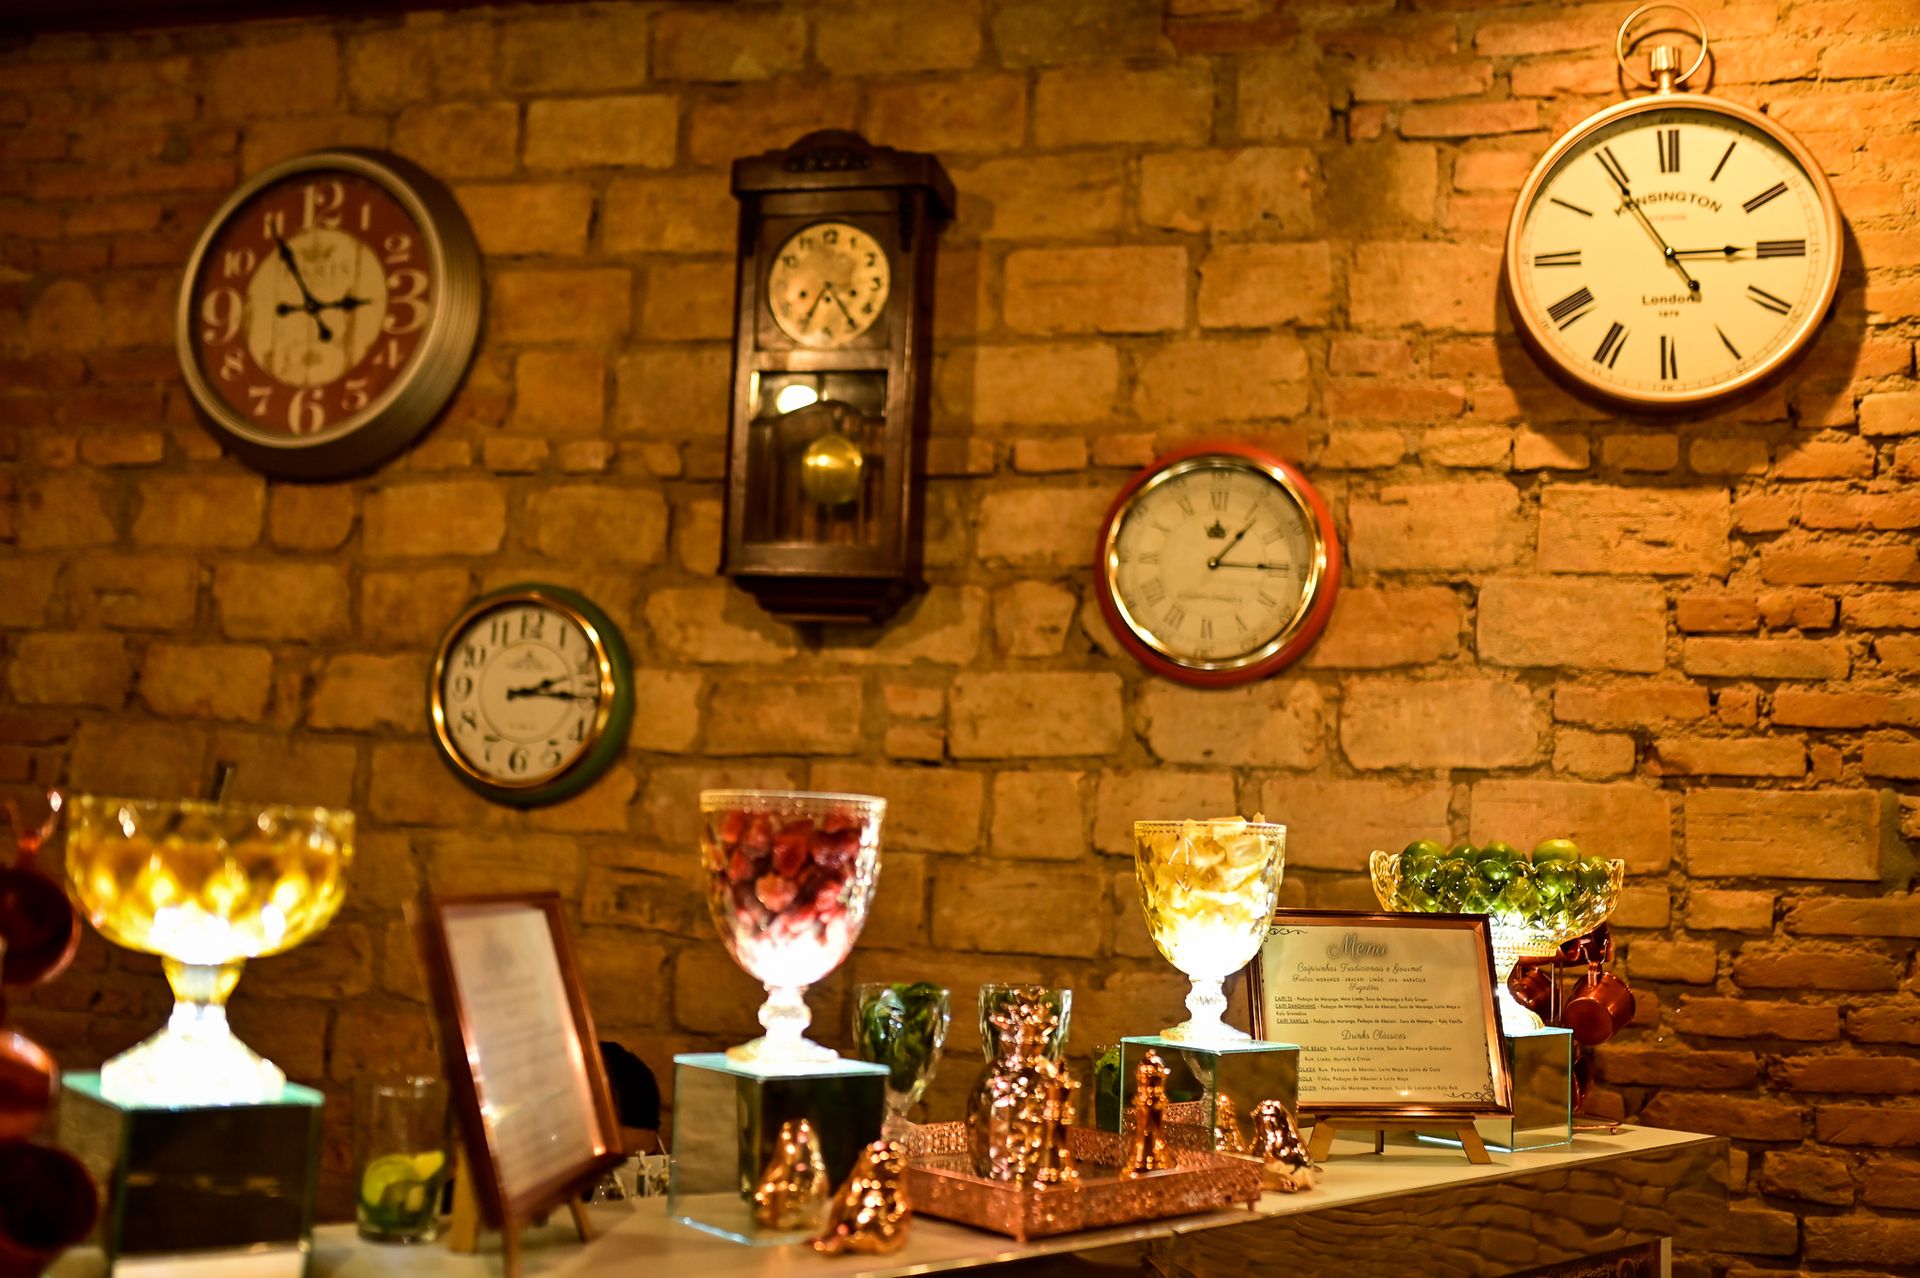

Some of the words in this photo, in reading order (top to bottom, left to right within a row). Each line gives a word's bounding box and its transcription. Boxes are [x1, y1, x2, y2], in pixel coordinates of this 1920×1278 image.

[1710, 141, 1736, 182] I
[302, 181, 344, 229] 12
[1742, 181, 1788, 214] II
[264, 210, 284, 239] 11
[360, 203, 371, 231] 1
[384, 233, 412, 264] 2
[823, 229, 838, 244] 12
[1756, 239, 1805, 258] III
[223, 250, 256, 278] 10
[866, 252, 875, 266] 2
[871, 276, 880, 292] 3
[383, 269, 430, 334] 3
[1642, 294, 1698, 305] London
[201, 287, 244, 345] 9
[220, 349, 244, 381] 8
[372, 338, 403, 369] 4
[248, 386, 272, 416] 7
[341, 378, 370, 411] 5
[288, 388, 325, 435] 6
[491, 618, 509, 647] 11
[520, 611, 545, 640] 12
[560, 620, 566, 649] 1
[464, 644, 485, 670] 10
[574, 646, 594, 675] 2
[452, 676, 472, 704] 9
[457, 710, 478, 734] 8
[568, 717, 585, 742] 4
[484, 734, 502, 762] 7
[508, 744, 529, 773] 6
[540, 738, 562, 768] 5
[1327, 932, 1388, 961] Menu
[1297, 962, 1337, 974] Caipirinhas
[1340, 963, 1384, 973] Tradicionais
[1392, 963, 1422, 974] Gourmet
[1349, 983, 1379, 994] Sugestões
[1341, 1029, 1370, 1040] Drinks
[1373, 1029, 1406, 1040] Clássicos
